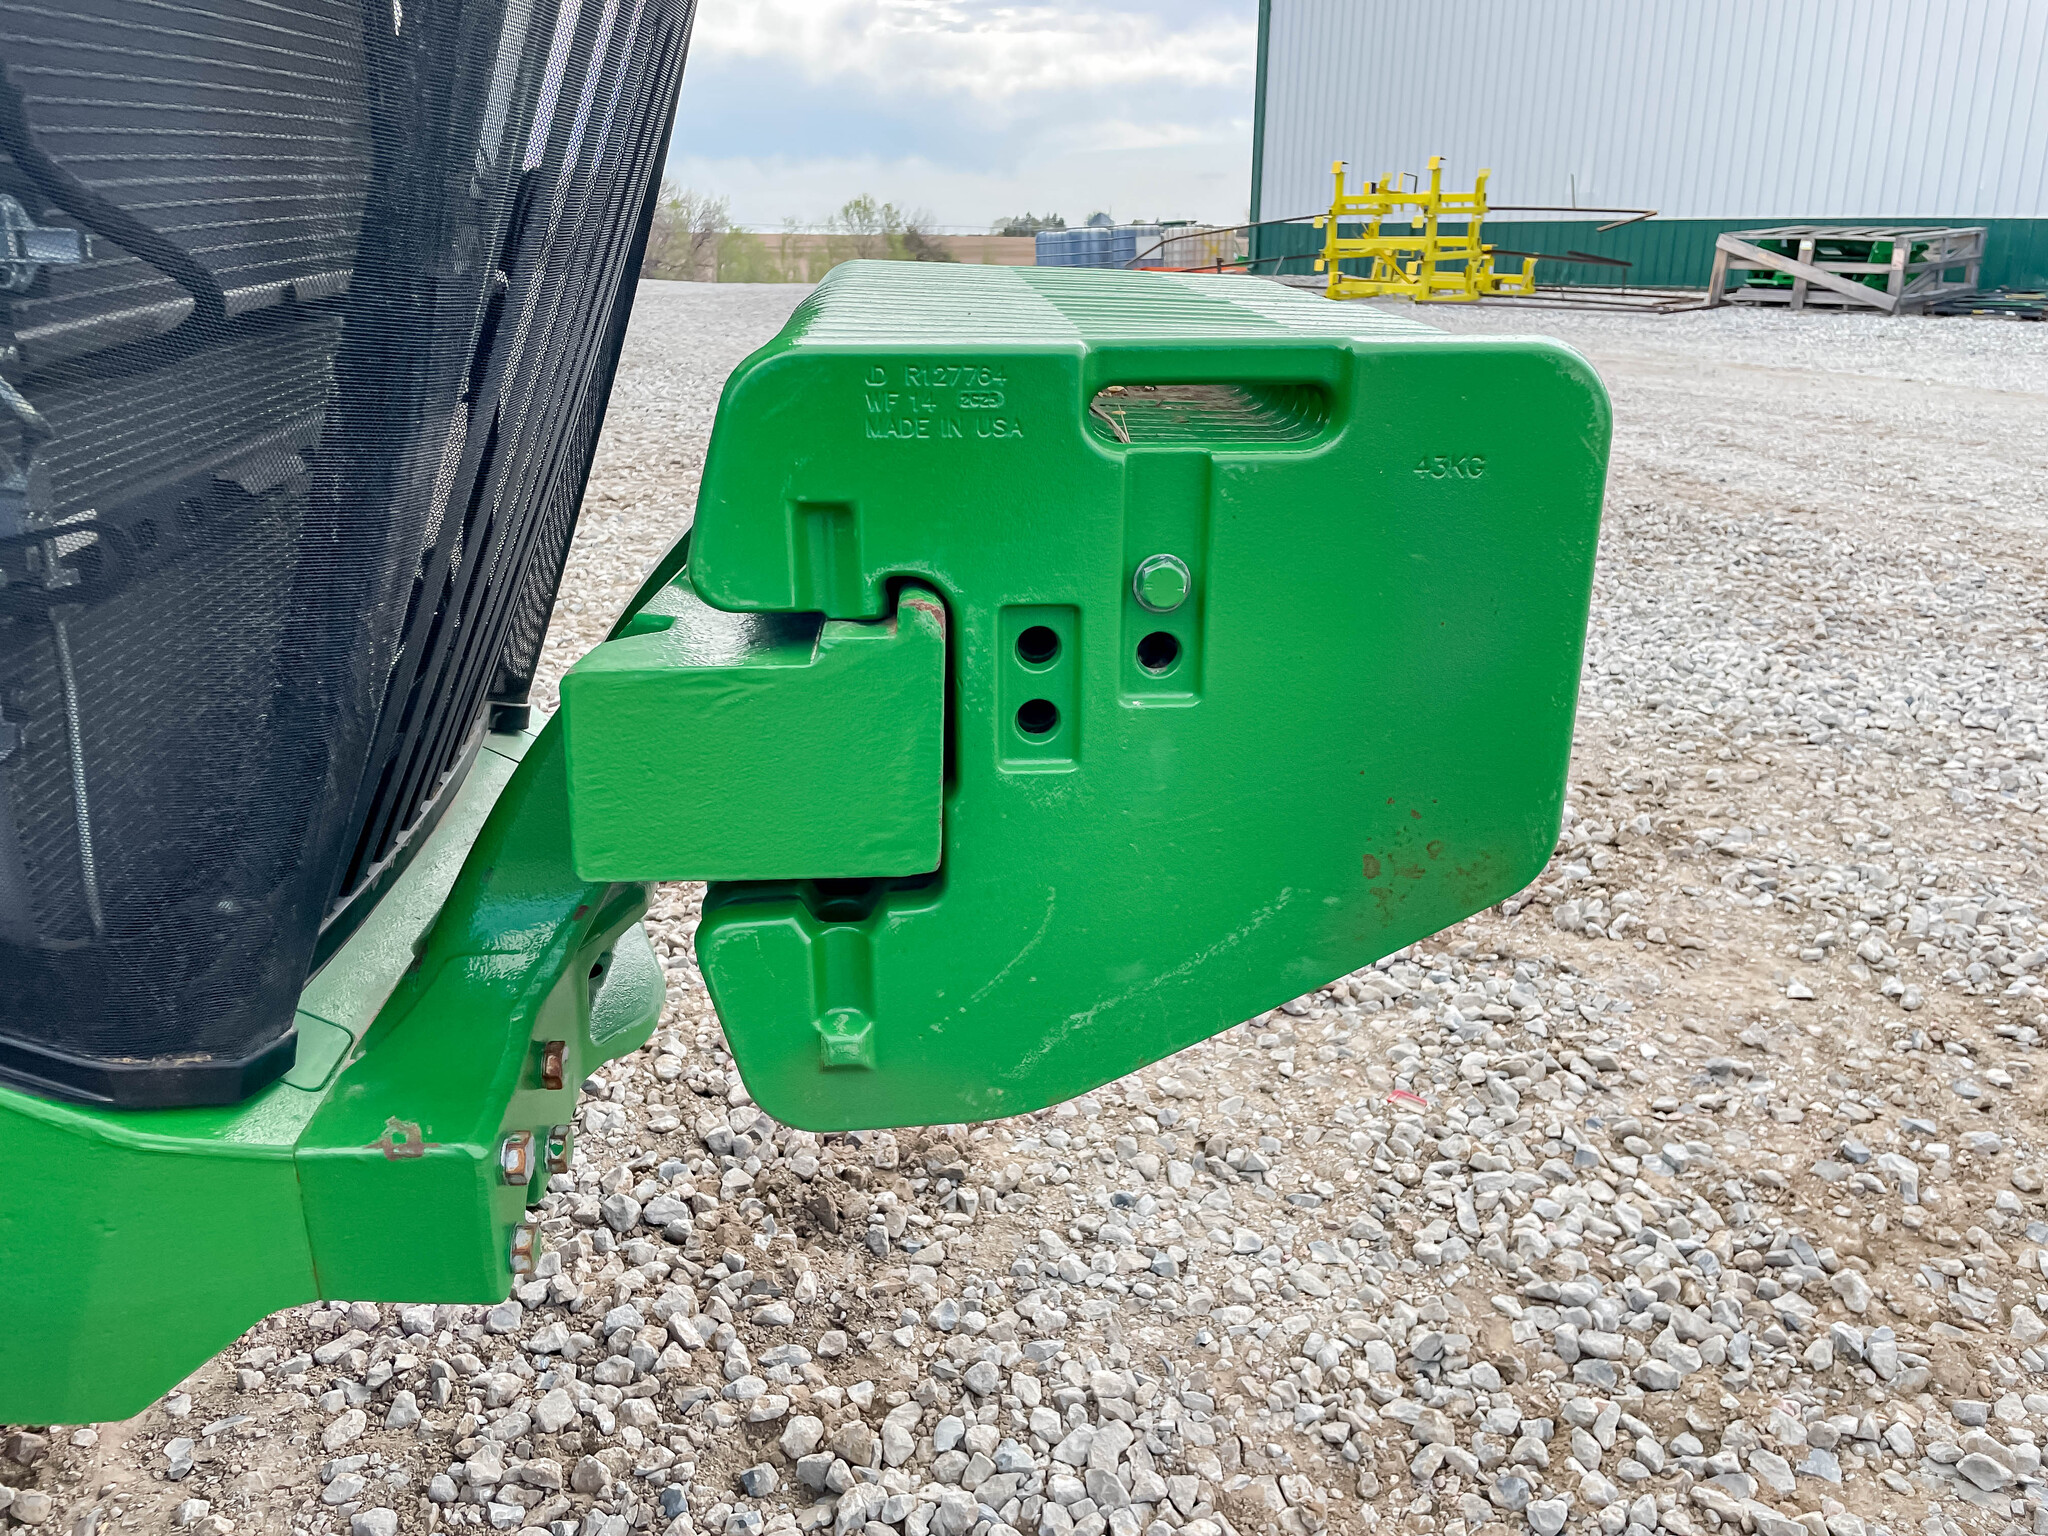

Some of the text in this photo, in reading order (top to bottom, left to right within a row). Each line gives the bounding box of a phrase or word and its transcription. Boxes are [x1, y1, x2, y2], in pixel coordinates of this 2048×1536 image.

[905, 366, 1007, 387] R127764
[865, 391, 899, 413] WF
[909, 392, 937, 413] 14
[865, 417, 1024, 439] MADE IN USA
